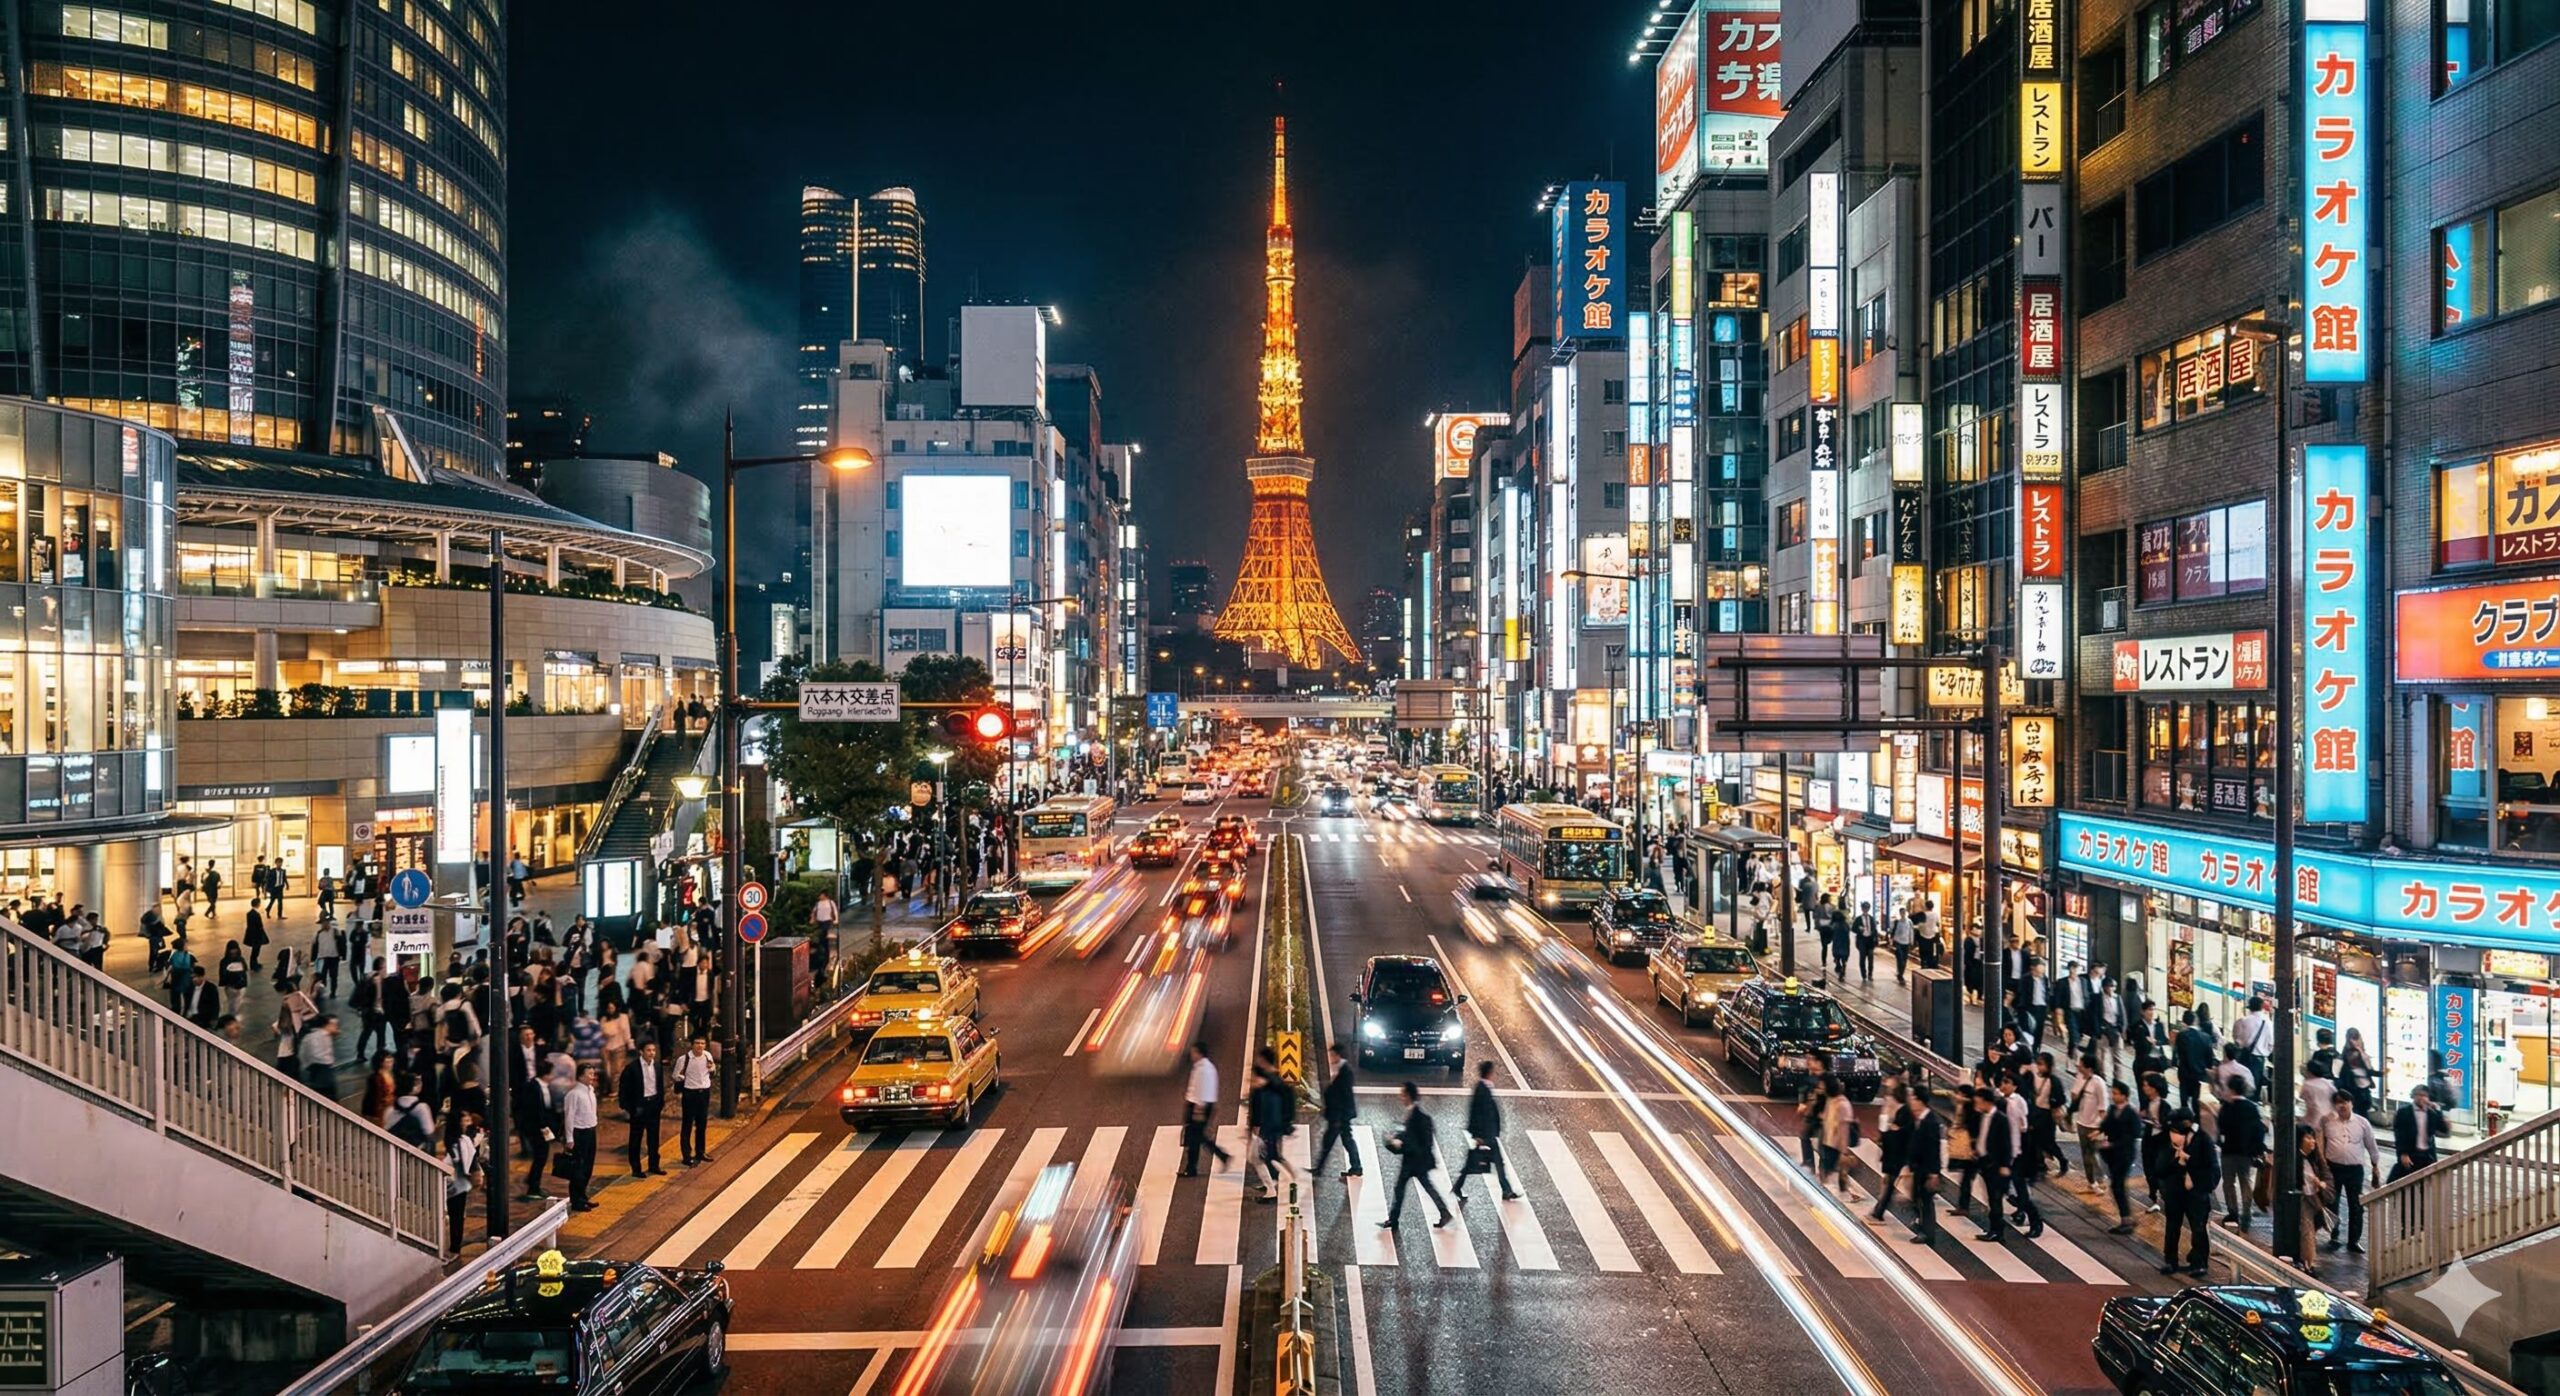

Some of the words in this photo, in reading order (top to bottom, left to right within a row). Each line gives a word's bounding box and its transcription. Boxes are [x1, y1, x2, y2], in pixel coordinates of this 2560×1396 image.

[2028, 0, 2054, 69] 居酒屋
[2032, 87, 2050, 167] レストラン
[2028, 206, 2054, 257] バー
[2312, 52, 2358, 352] カラオケ館
[1584, 189, 1612, 329] カラオケ館
[2029, 293, 2054, 368] 居酒屋
[2176, 338, 2254, 401] 居酒屋
[2033, 388, 2050, 449] レストラ
[2031, 490, 2052, 572] レストラン
[2144, 647, 2229, 682] レストラン
[2312, 487, 2358, 772] カラオケ館
[804, 687, 895, 706] 六本木交差点
[746, 890, 760, 903] 30
[2079, 828, 2169, 875] カラオケ館
[2200, 849, 2321, 904] カラオ館
